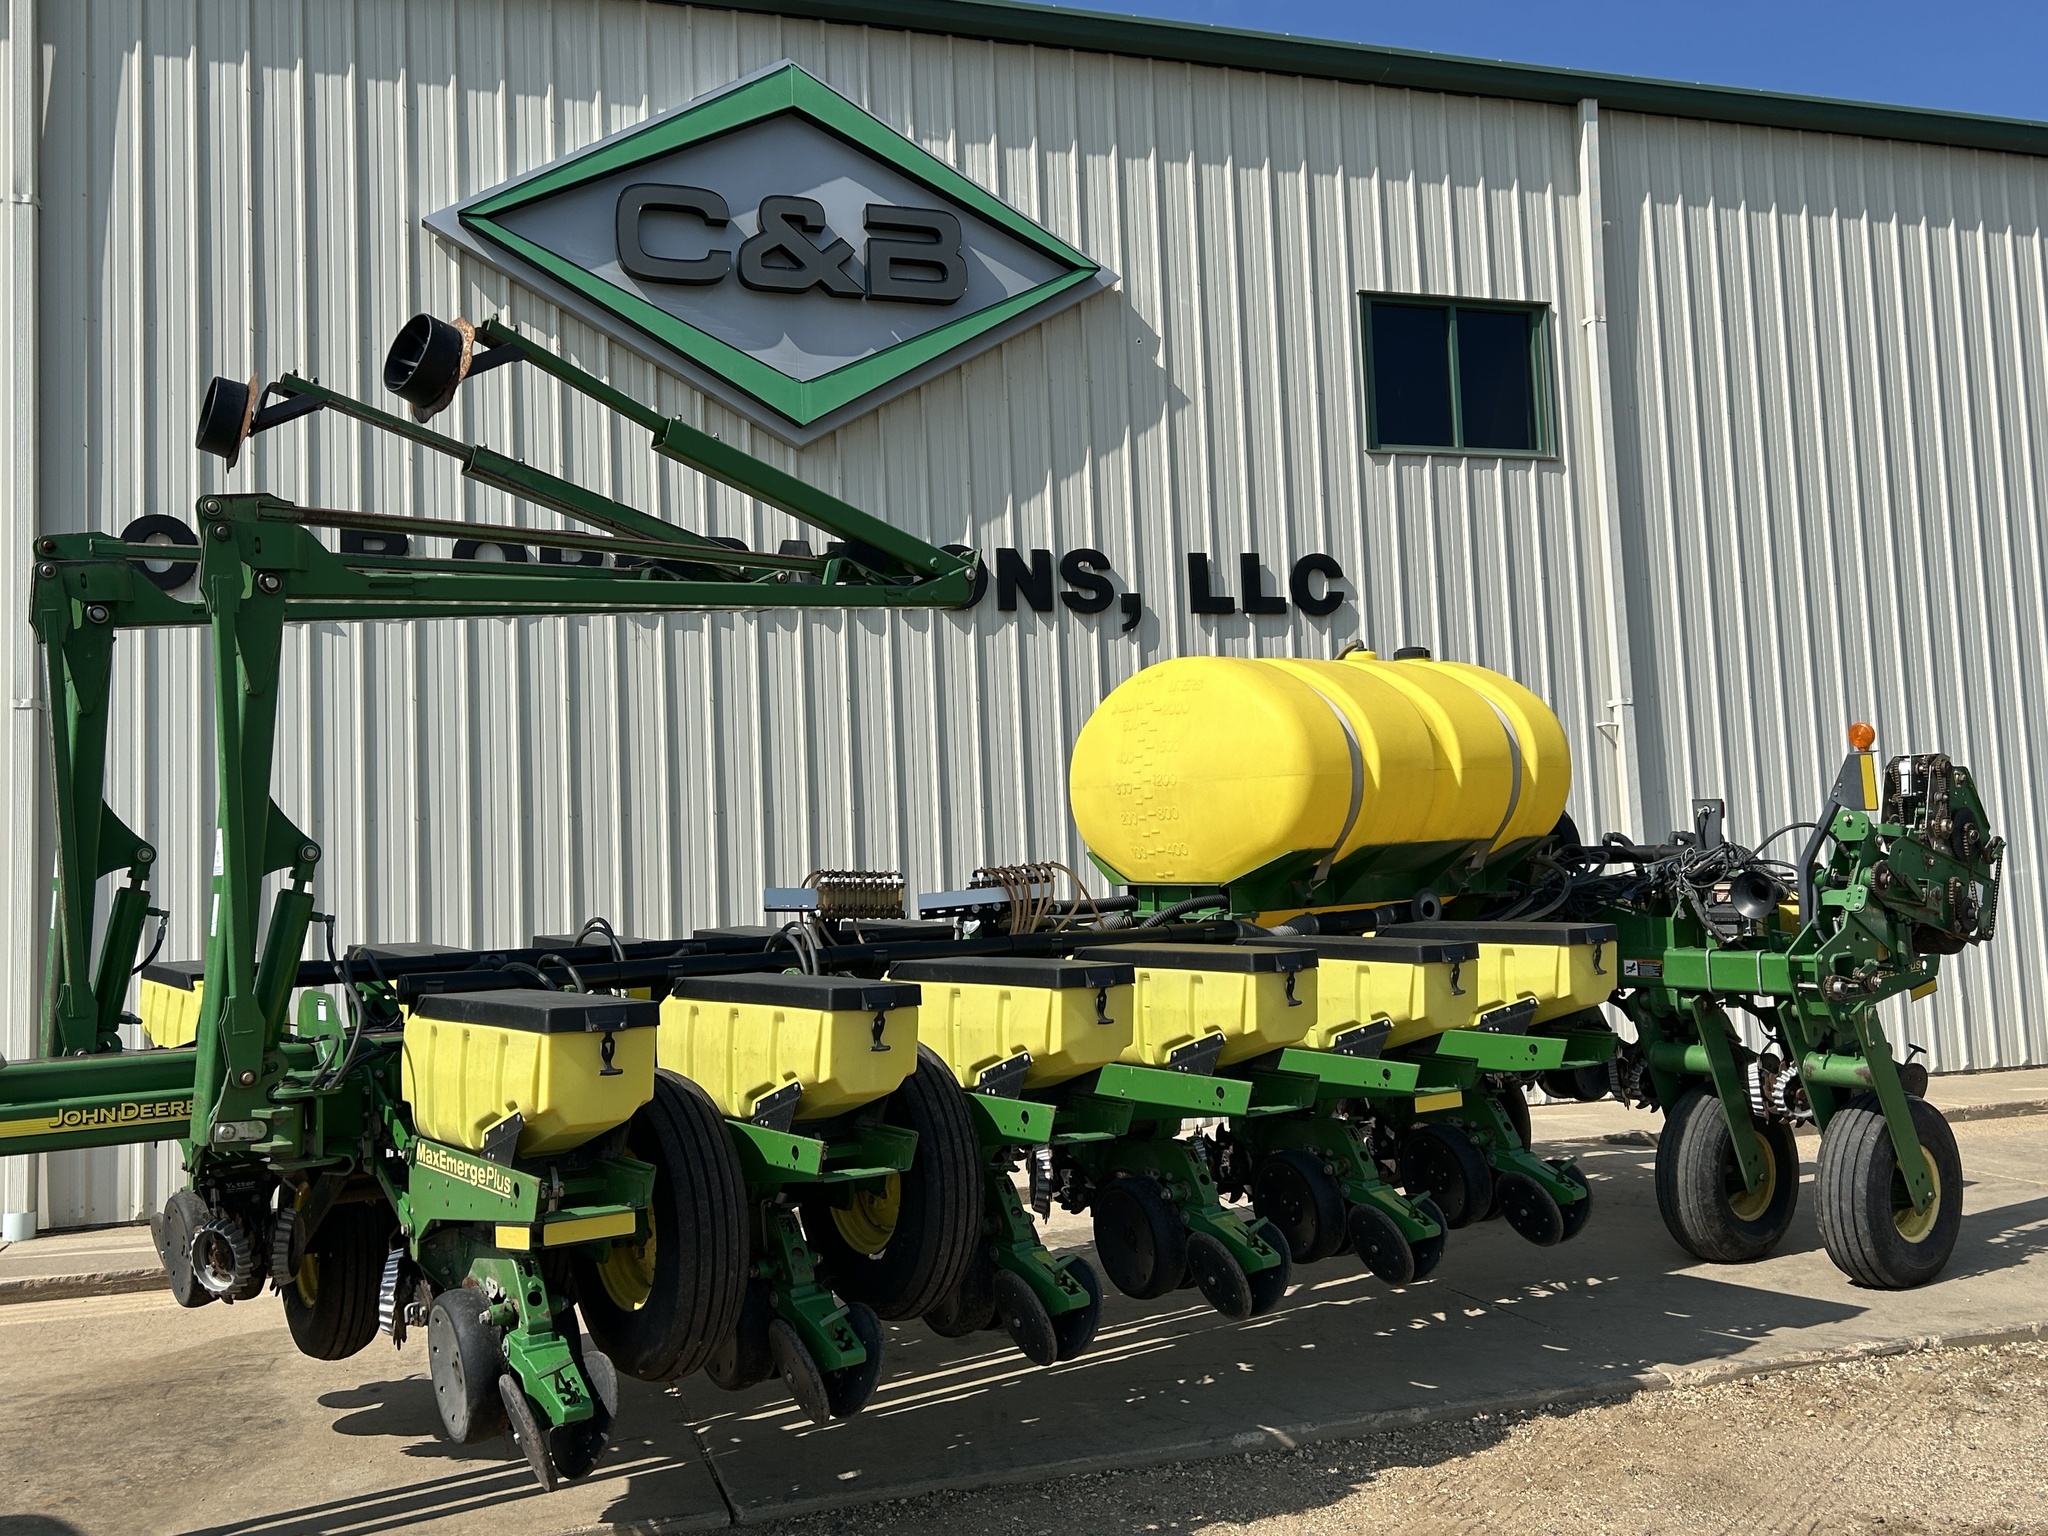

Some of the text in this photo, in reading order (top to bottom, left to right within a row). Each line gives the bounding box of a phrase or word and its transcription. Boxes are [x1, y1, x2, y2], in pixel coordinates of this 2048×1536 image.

[615, 182, 969, 306] C&B
[1187, 551, 1345, 616] LLC
[1161, 703, 1191, 716] 2000
[1153, 773, 1178, 787] 1200
[1116, 783, 1133, 795] 300
[1120, 811, 1138, 825] 200
[1157, 805, 1179, 820] 800
[1130, 845, 1147, 859] 100
[1166, 842, 1189, 856] 400
[49, 1107, 116, 1127] JOHN
[416, 1142, 511, 1189] MaxEmergePlus
